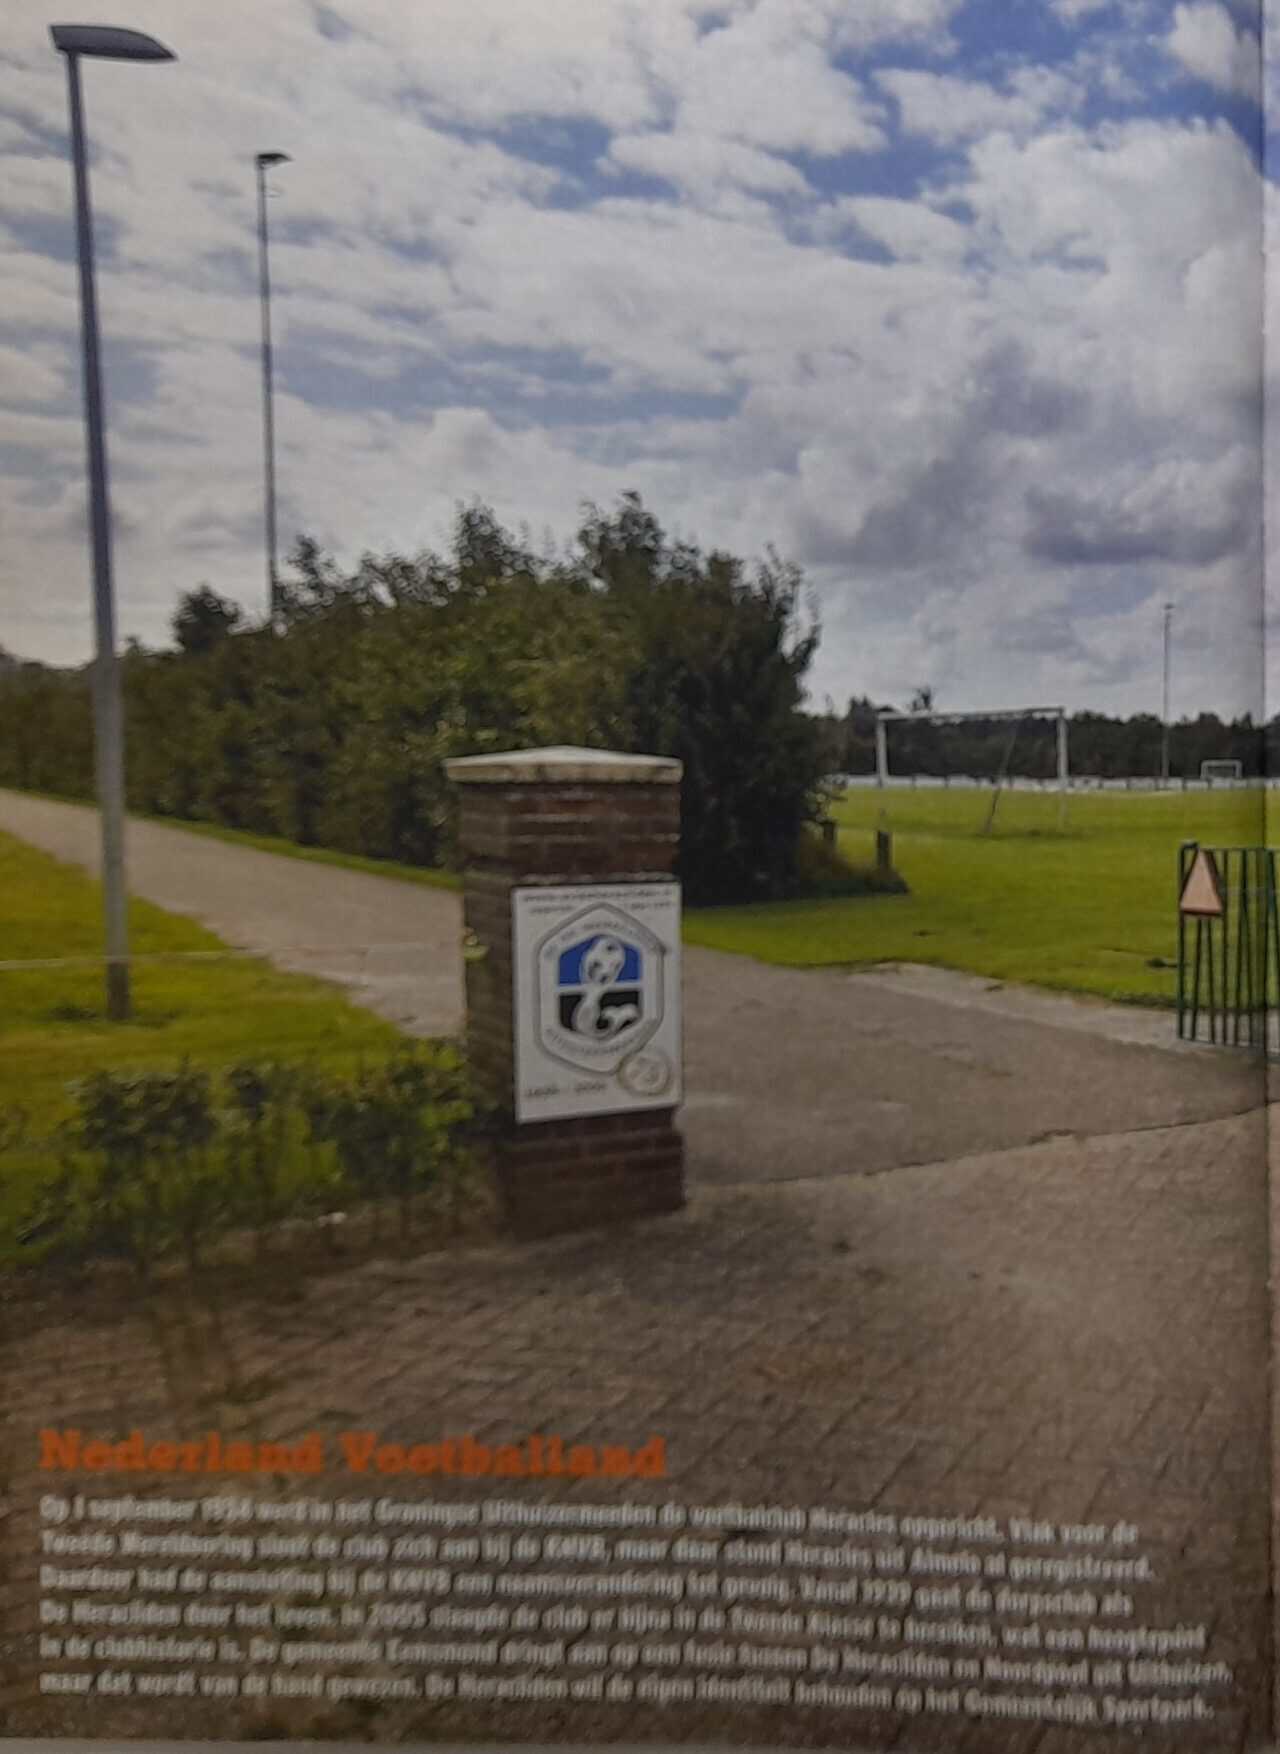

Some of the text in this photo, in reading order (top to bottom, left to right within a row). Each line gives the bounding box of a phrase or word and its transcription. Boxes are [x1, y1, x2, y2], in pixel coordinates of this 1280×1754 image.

[39, 1429, 668, 1478] Nederland Voetballand
[88, 1495, 198, 1525] september
